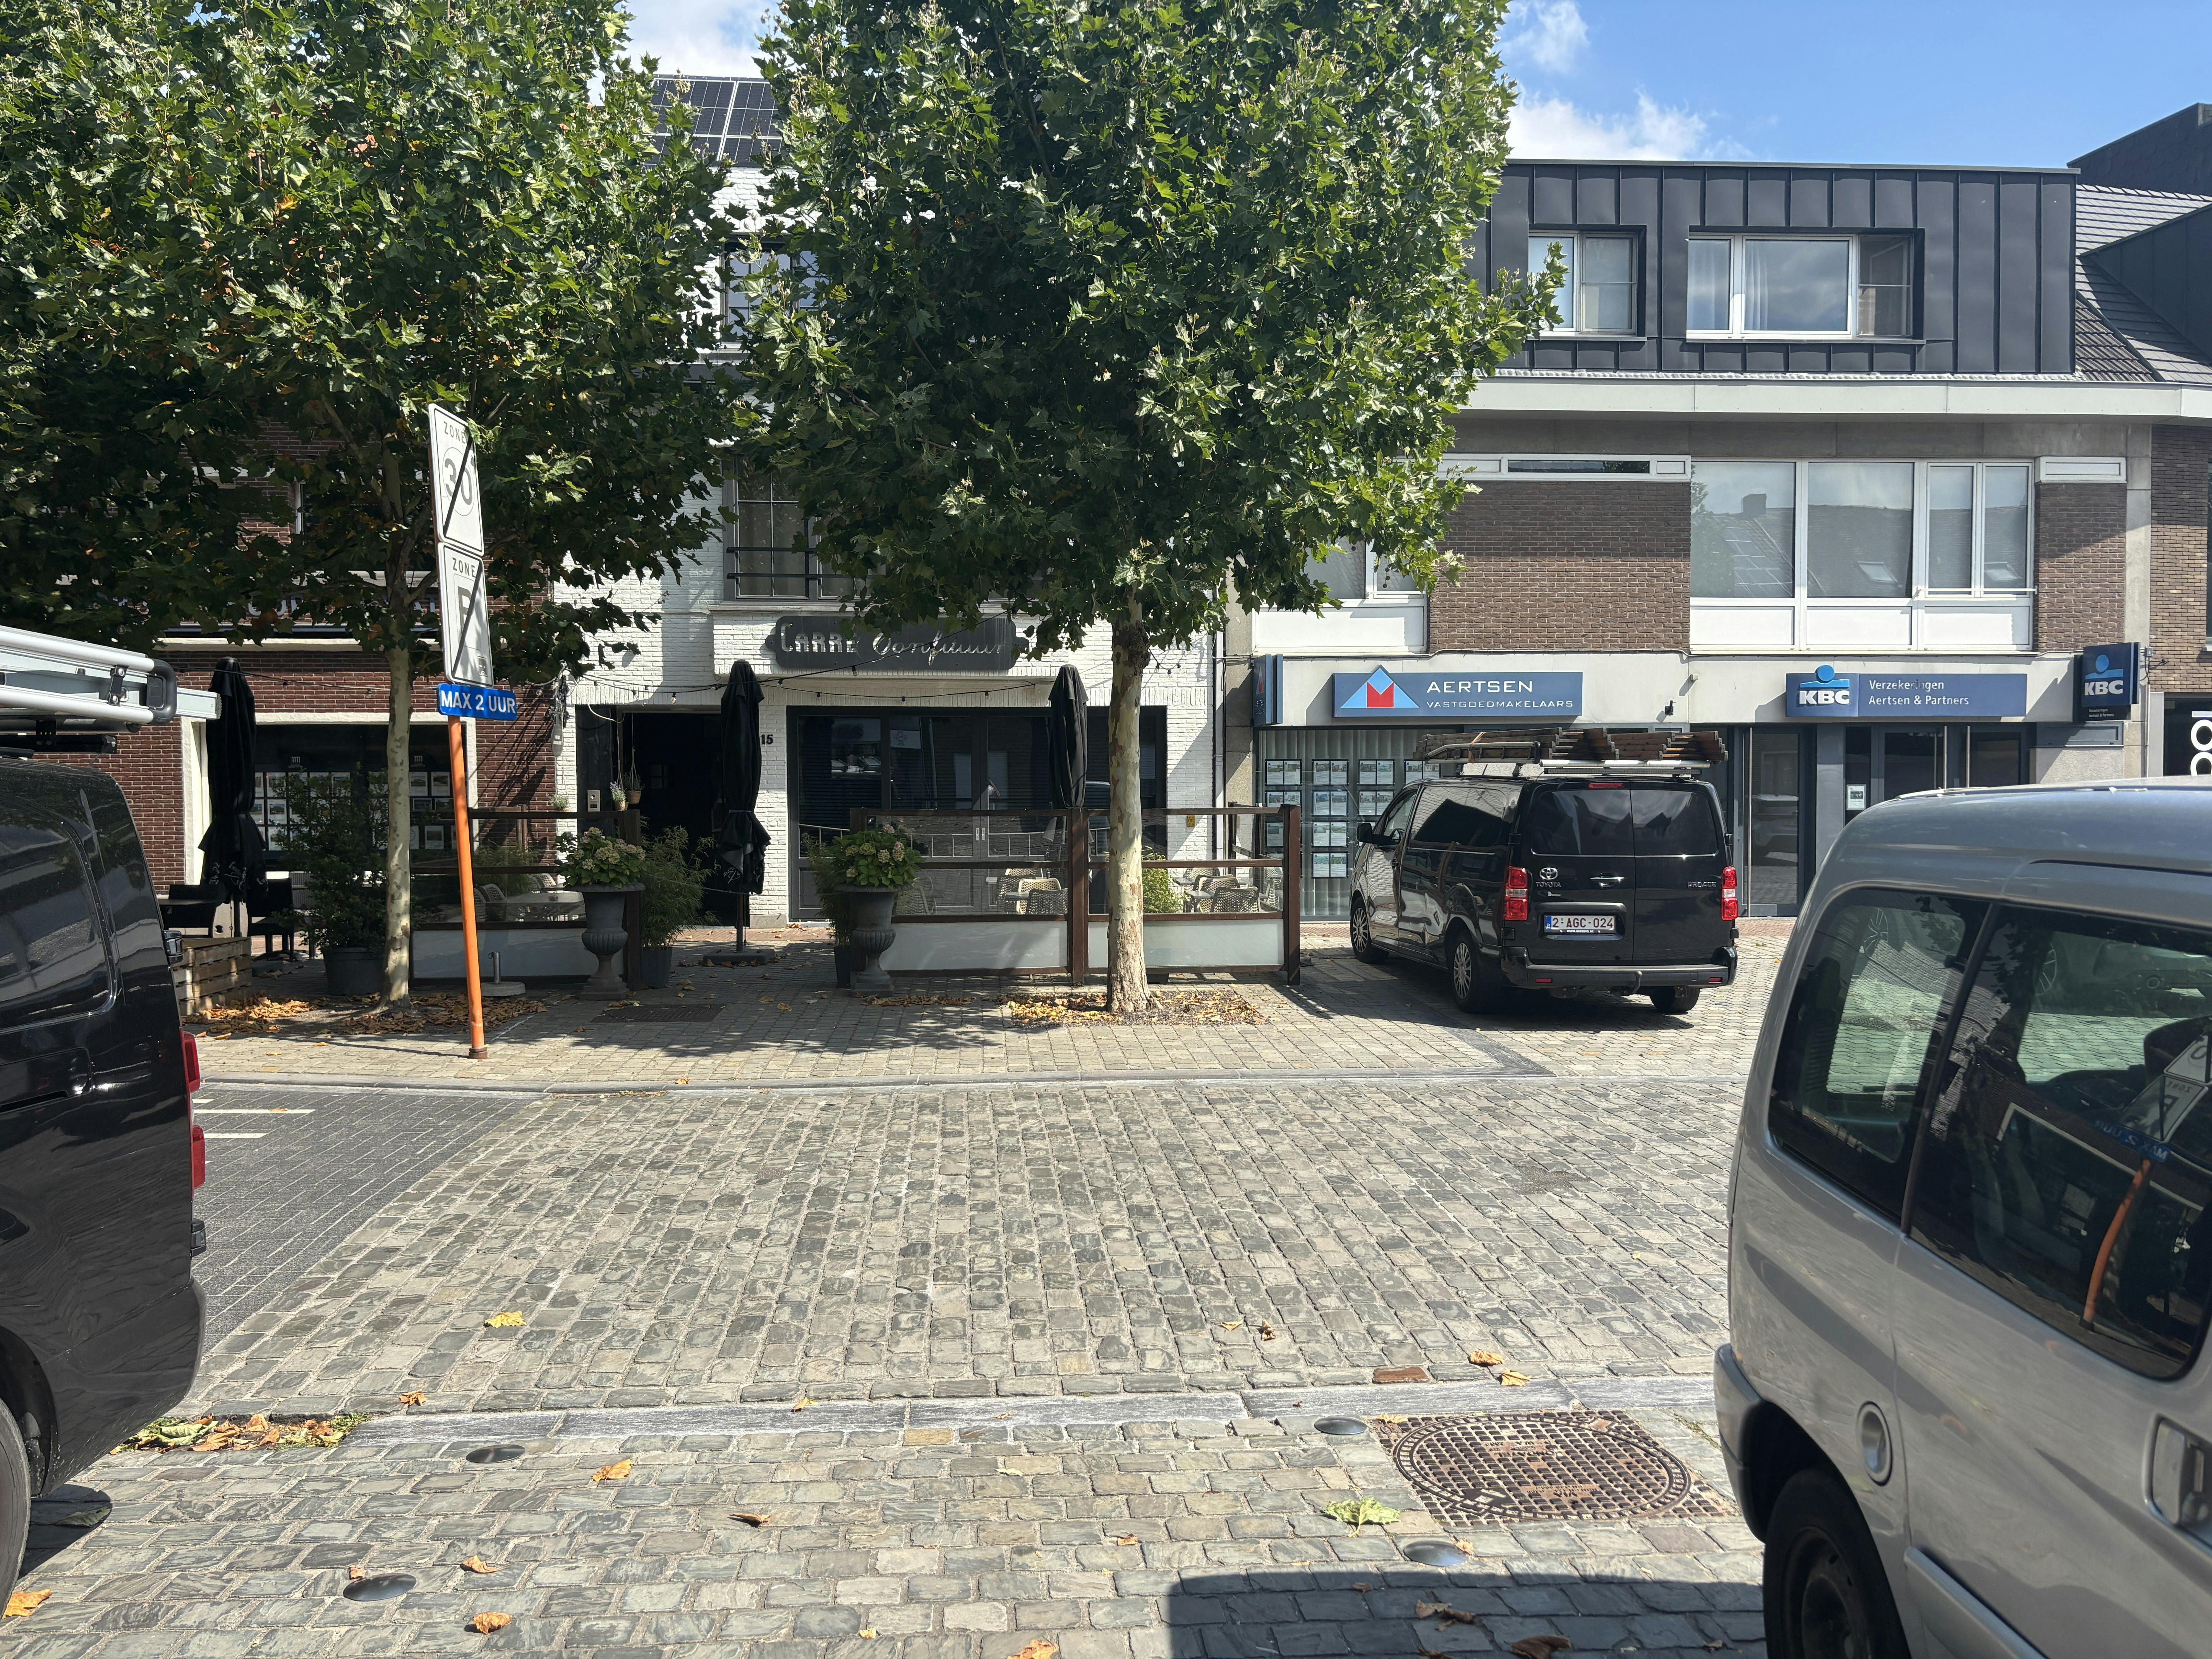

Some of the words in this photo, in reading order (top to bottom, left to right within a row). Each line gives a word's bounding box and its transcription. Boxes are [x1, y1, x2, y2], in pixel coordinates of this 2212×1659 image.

[443, 421, 465, 444] ZONE
[445, 458, 472, 505] 30
[452, 557, 476, 577] ZONE
[1426, 680, 1533, 693] AERTSEN
[2085, 680, 2123, 696] KBC
[441, 690, 472, 710] MAX
[475, 694, 484, 711] 2
[488, 696, 516, 714] UUR
[1799, 690, 1850, 704] KBC
[1869, 695, 1910, 705] Aertsen
[1914, 696, 1922, 705] &
[1925, 695, 1969, 705] Partners
[761, 734, 774, 745] 15
